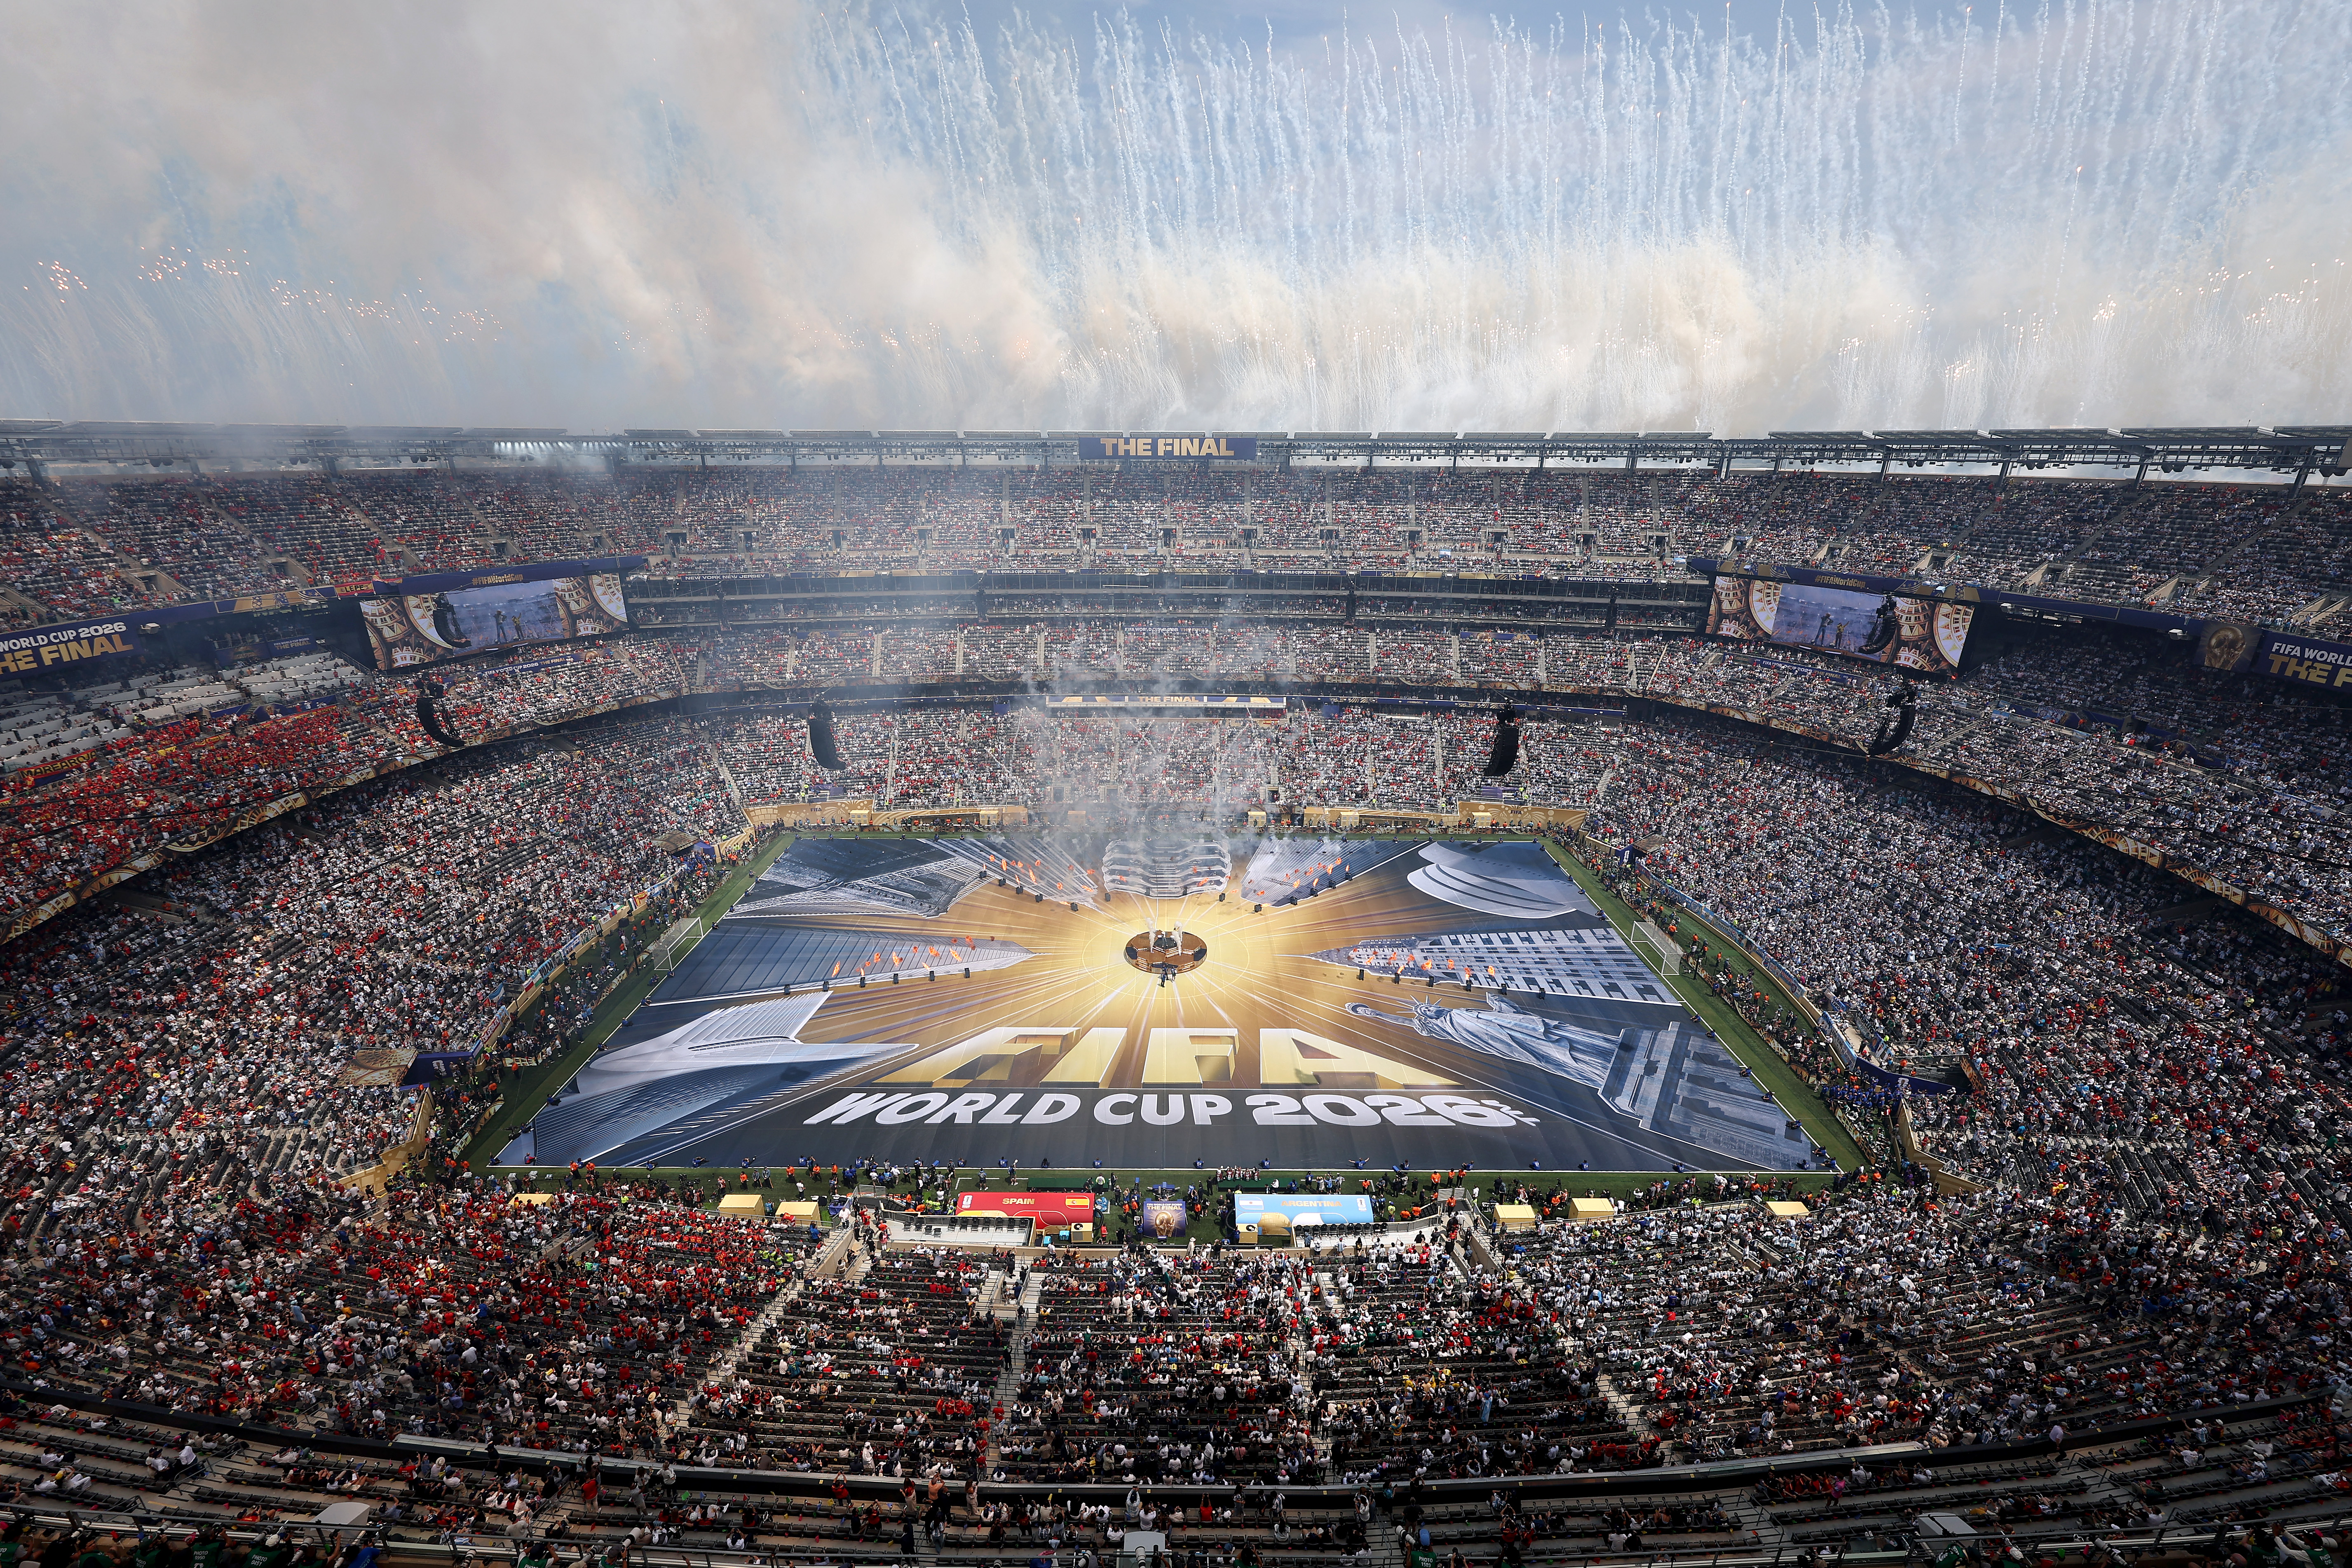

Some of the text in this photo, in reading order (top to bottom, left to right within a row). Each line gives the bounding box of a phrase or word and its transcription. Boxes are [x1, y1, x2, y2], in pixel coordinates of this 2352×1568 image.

[1100, 438, 1234, 456] THE FINAL
[472, 574, 523, 586] #FIFAWorldCup
[1815, 575, 1866, 589] #FIFAWorldCup
[49, 630, 77, 643] CUP
[78, 622, 127, 638] 2026
[0, 634, 134, 674] HE FINAL
[290, 641, 311, 649] FINAL
[2272, 642, 2352, 666] FIFA WORLD
[2269, 654, 2333, 684] THE
[872, 1027, 1463, 1085] FIFA
[803, 1093, 1517, 1127] WORLD CUP 2026
[251, 1554, 268, 1562] PHOTO
